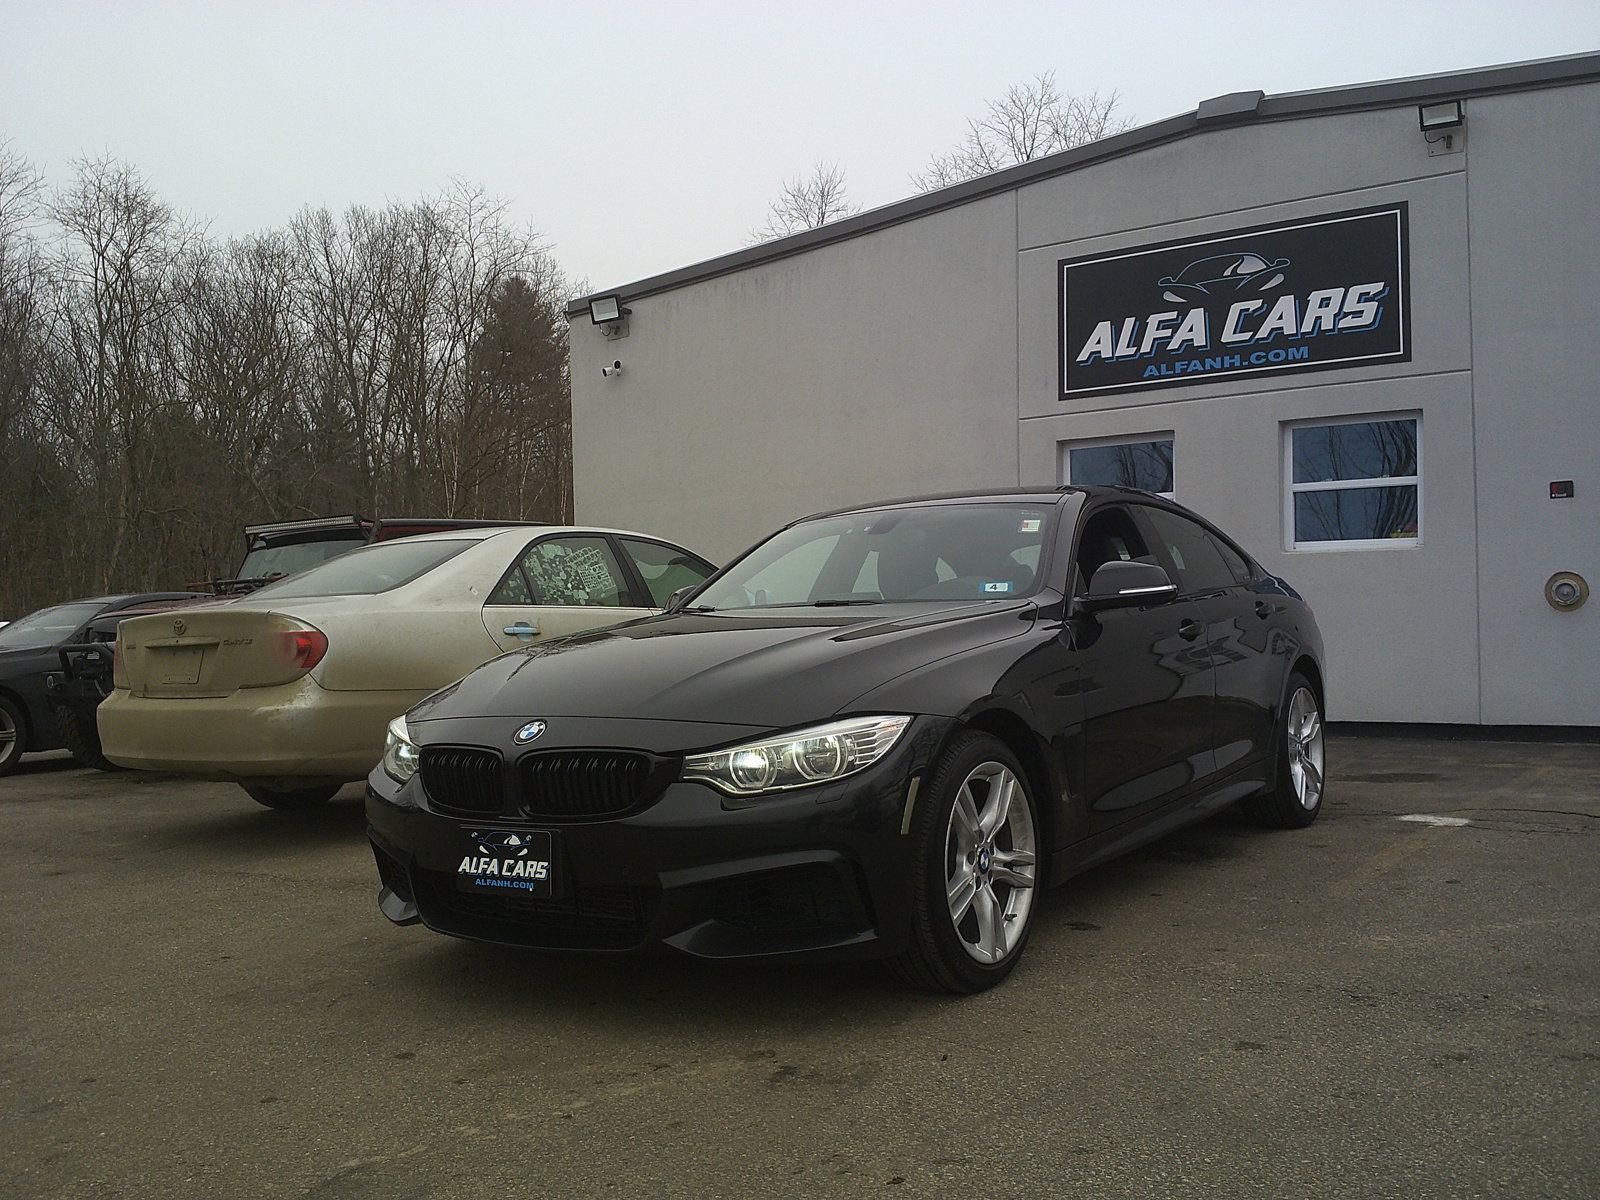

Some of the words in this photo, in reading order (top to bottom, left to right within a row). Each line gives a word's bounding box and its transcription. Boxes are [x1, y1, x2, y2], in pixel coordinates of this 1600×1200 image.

[1076, 308, 1209, 364] ALFA
[1220, 282, 1388, 346] CARS
[1143, 346, 1309, 378] ALFANH.COM
[458, 856, 499, 876] ALFA
[502, 859, 549, 880] CARS
[475, 878, 534, 889] ALFANH.COM
